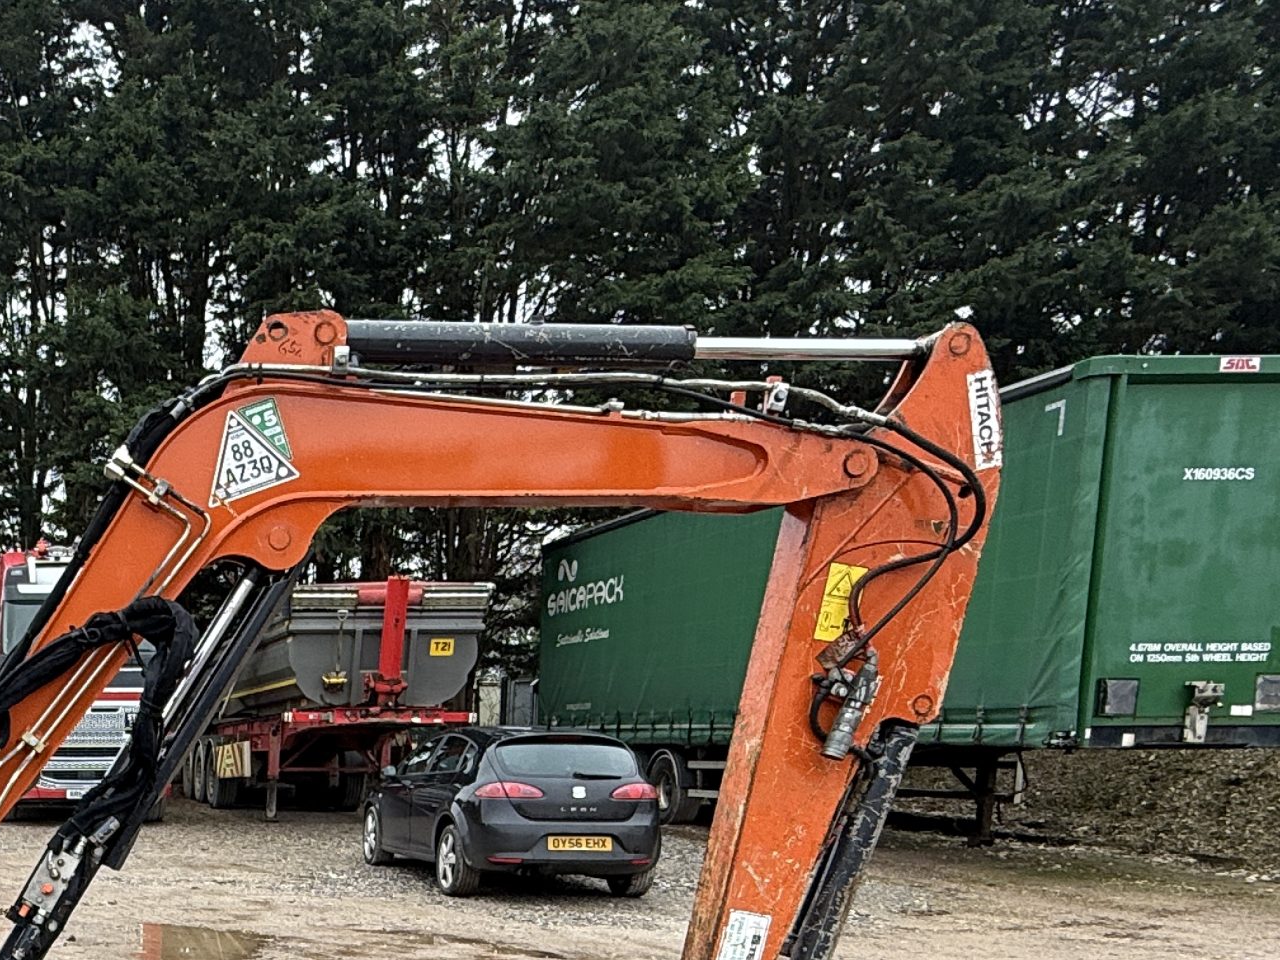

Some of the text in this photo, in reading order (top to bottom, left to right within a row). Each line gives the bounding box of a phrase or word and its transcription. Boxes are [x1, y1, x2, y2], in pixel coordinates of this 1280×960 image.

[1223, 358, 1257, 370] SDC
[263, 409, 277, 427] 5
[231, 439, 254, 462] 88
[223, 455, 274, 488] AZ3Q
[1182, 467, 1255, 481] X160936CS
[547, 574, 624, 617] SAICAPACK
[1164, 642, 1203, 652] OVERALL
[1206, 642, 1239, 652] HEIGHT
[1241, 641, 1272, 652] BASED
[1129, 653, 1144, 663] ON
[1202, 653, 1233, 662] WHEEL
[1235, 652, 1269, 662] HEIGHT
[585, 838, 608, 849] EHX
